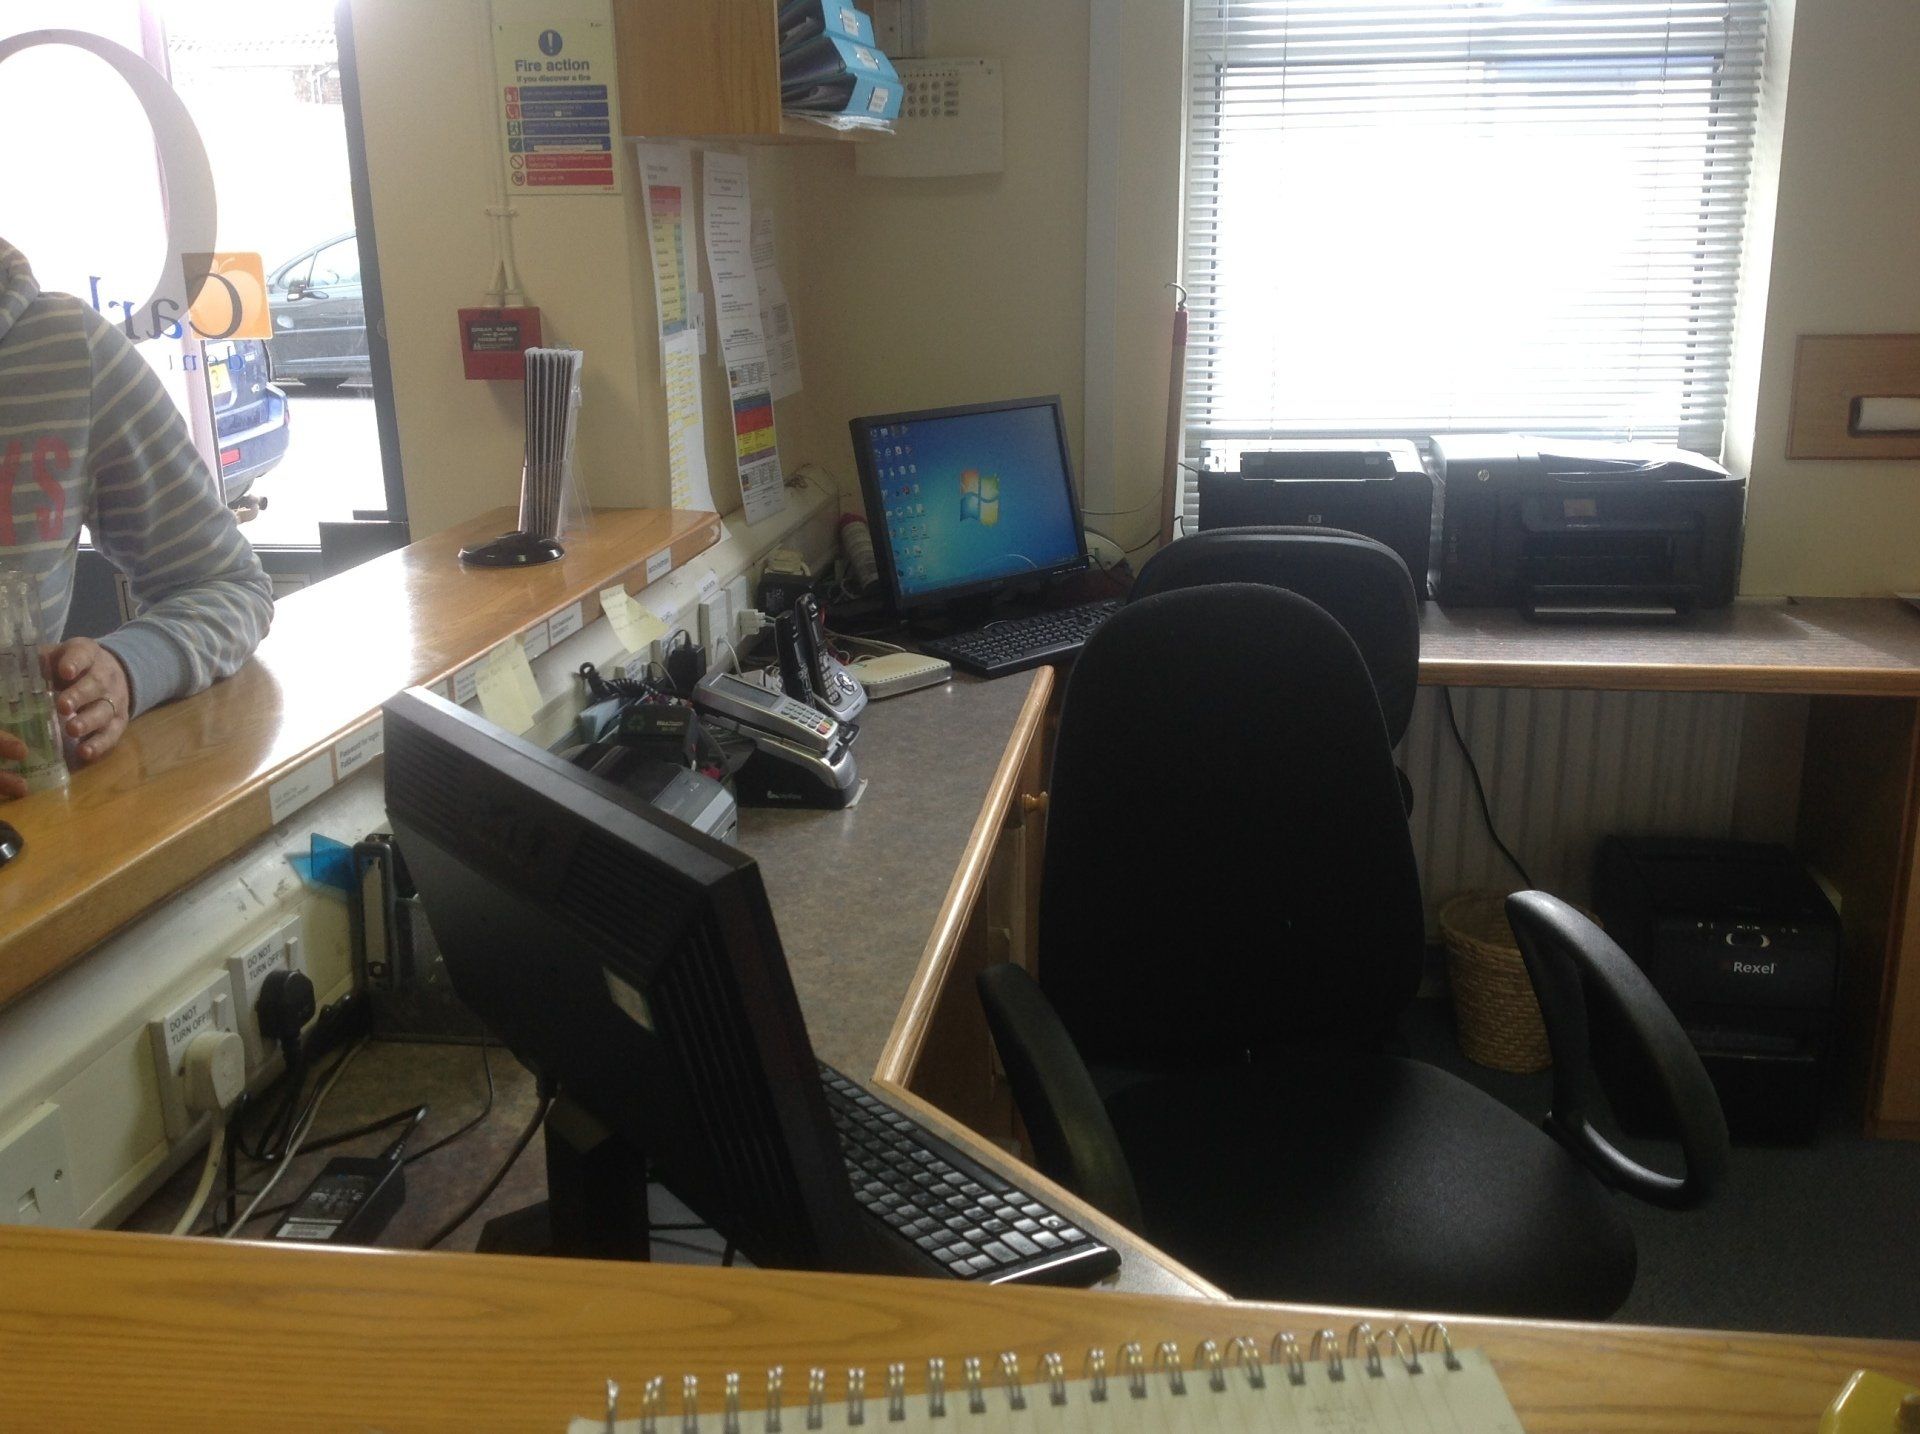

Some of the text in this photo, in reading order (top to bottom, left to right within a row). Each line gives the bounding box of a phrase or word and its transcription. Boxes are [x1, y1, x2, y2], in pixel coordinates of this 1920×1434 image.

[514, 58, 590, 72] Fire action
[247, 944, 271, 969] DO NOT
[249, 961, 267, 980] TURN
[1733, 961, 1774, 974] Rexel
[169, 1006, 197, 1033] DO NOT
[171, 1024, 192, 1045] TURN
